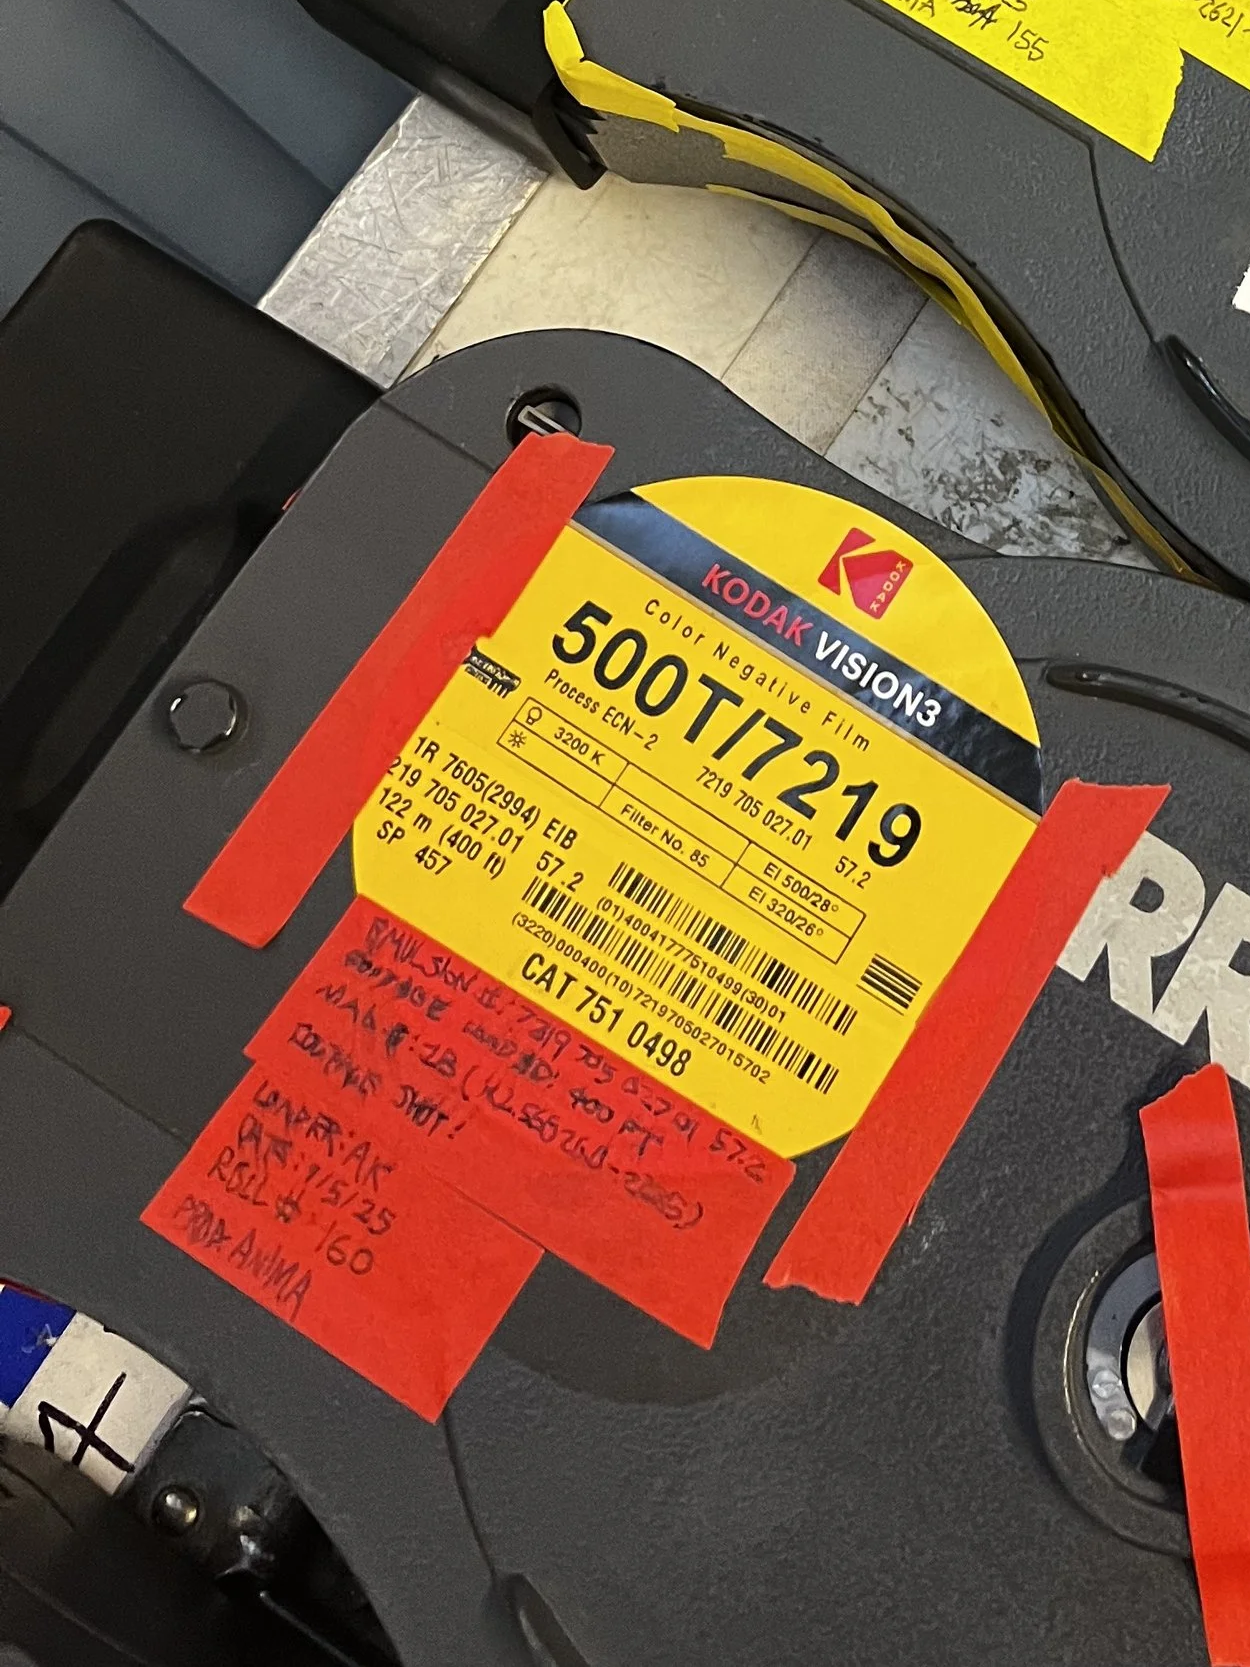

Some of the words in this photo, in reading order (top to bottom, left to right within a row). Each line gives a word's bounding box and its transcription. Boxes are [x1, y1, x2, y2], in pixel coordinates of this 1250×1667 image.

[1003, 21, 1053, 65] 155
[867, 557, 909, 615] KODAK
[543, 668, 599, 713] Process
[644, 598, 705, 644] Color
[712, 641, 810, 713] Negative
[821, 710, 869, 751] Film
[703, 565, 813, 649] KODAK
[815, 630, 941, 726] VISION3
[552, 600, 921, 867] 500T/7219
[553, 726, 589, 755] 3200
[590, 750, 605, 765] K
[378, 787, 412, 818] 122
[412, 812, 432, 832] m
[438, 824, 482, 860] (400
[482, 851, 505, 880] ft)
[382, 754, 422, 787] 219
[423, 778, 461, 811] 705
[460, 803, 524, 853] 027.01
[413, 736, 439, 763] 1R
[441, 752, 540, 830] 7605(2994)
[542, 817, 577, 849] EIB
[620, 803, 658, 834] Filter
[660, 829, 683, 854] No.
[689, 848, 709, 867] 85
[695, 765, 733, 798] 7219
[733, 789, 763, 817] 705
[762, 809, 812, 850] 027.01
[834, 855, 871, 889] 57.2
[376, 820, 405, 844] SP
[414, 845, 452, 875] 457
[763, 861, 781, 880] EI
[781, 874, 838, 912] 500/28°
[748, 885, 766, 903] EI
[766, 898, 823, 936] 320/26°
[590, 896, 786, 1023] (01)40041777510499(30)01
[521, 952, 578, 999] CAT
[575, 984, 624, 1032] 751
[626, 1020, 691, 1076] 0498
[231, 1234, 318, 1323] ANIMA
